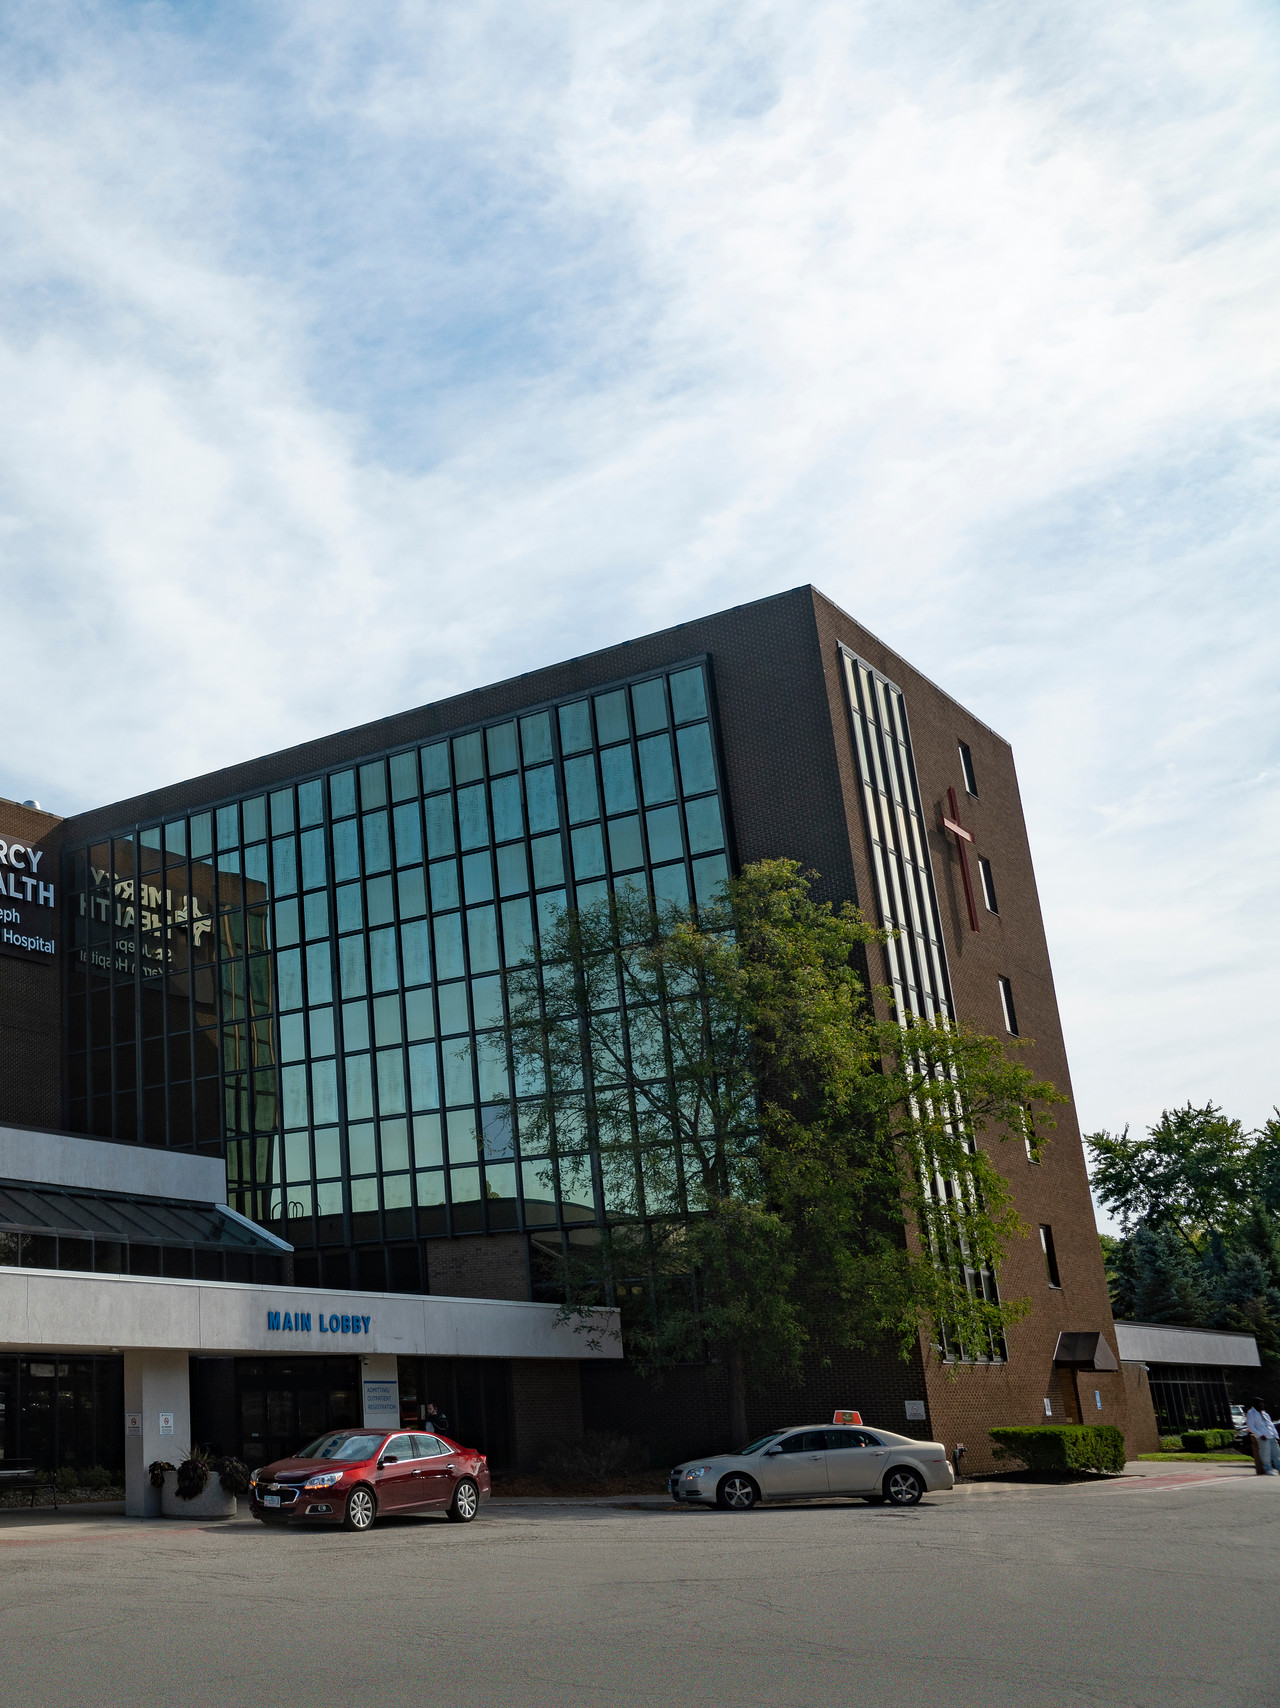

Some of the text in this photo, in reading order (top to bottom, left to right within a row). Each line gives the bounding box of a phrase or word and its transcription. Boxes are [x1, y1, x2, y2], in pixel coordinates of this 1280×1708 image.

[3, 928, 55, 954] Hospital
[268, 1311, 371, 1334] MAIN LOBBY
